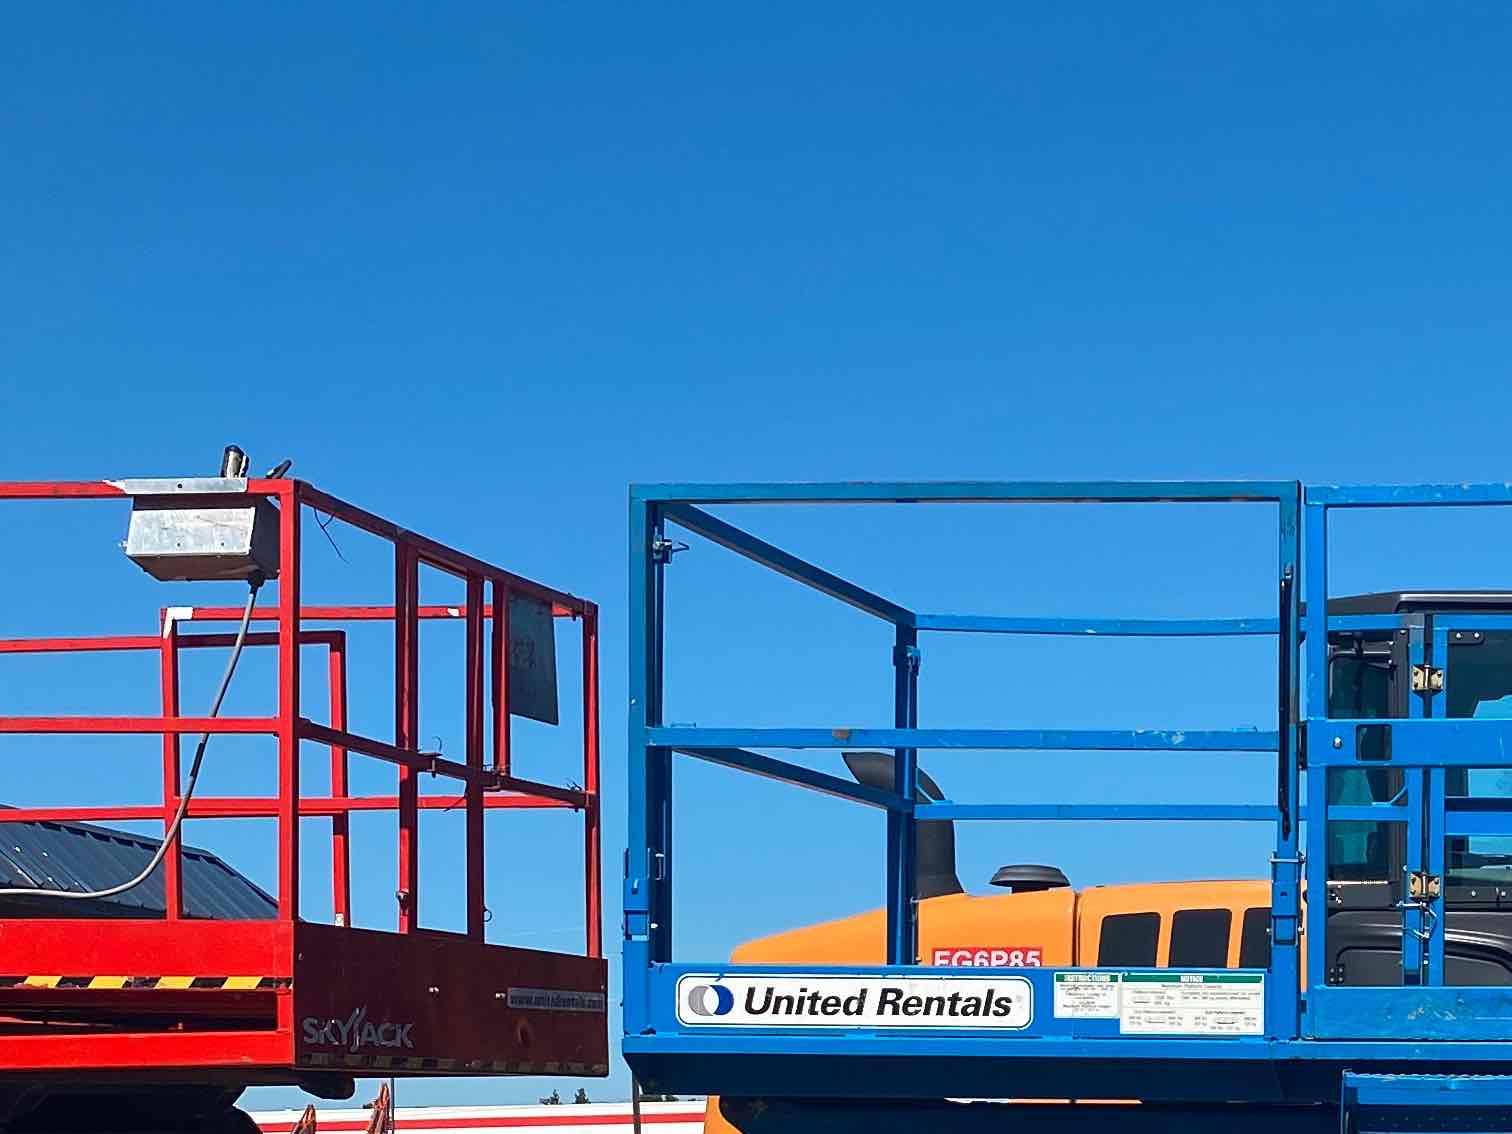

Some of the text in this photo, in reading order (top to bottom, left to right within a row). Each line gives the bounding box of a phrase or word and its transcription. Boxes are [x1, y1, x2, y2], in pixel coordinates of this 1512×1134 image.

[744, 986, 1014, 1018] United Rentals
[303, 1003, 415, 1053] SKYJACK
